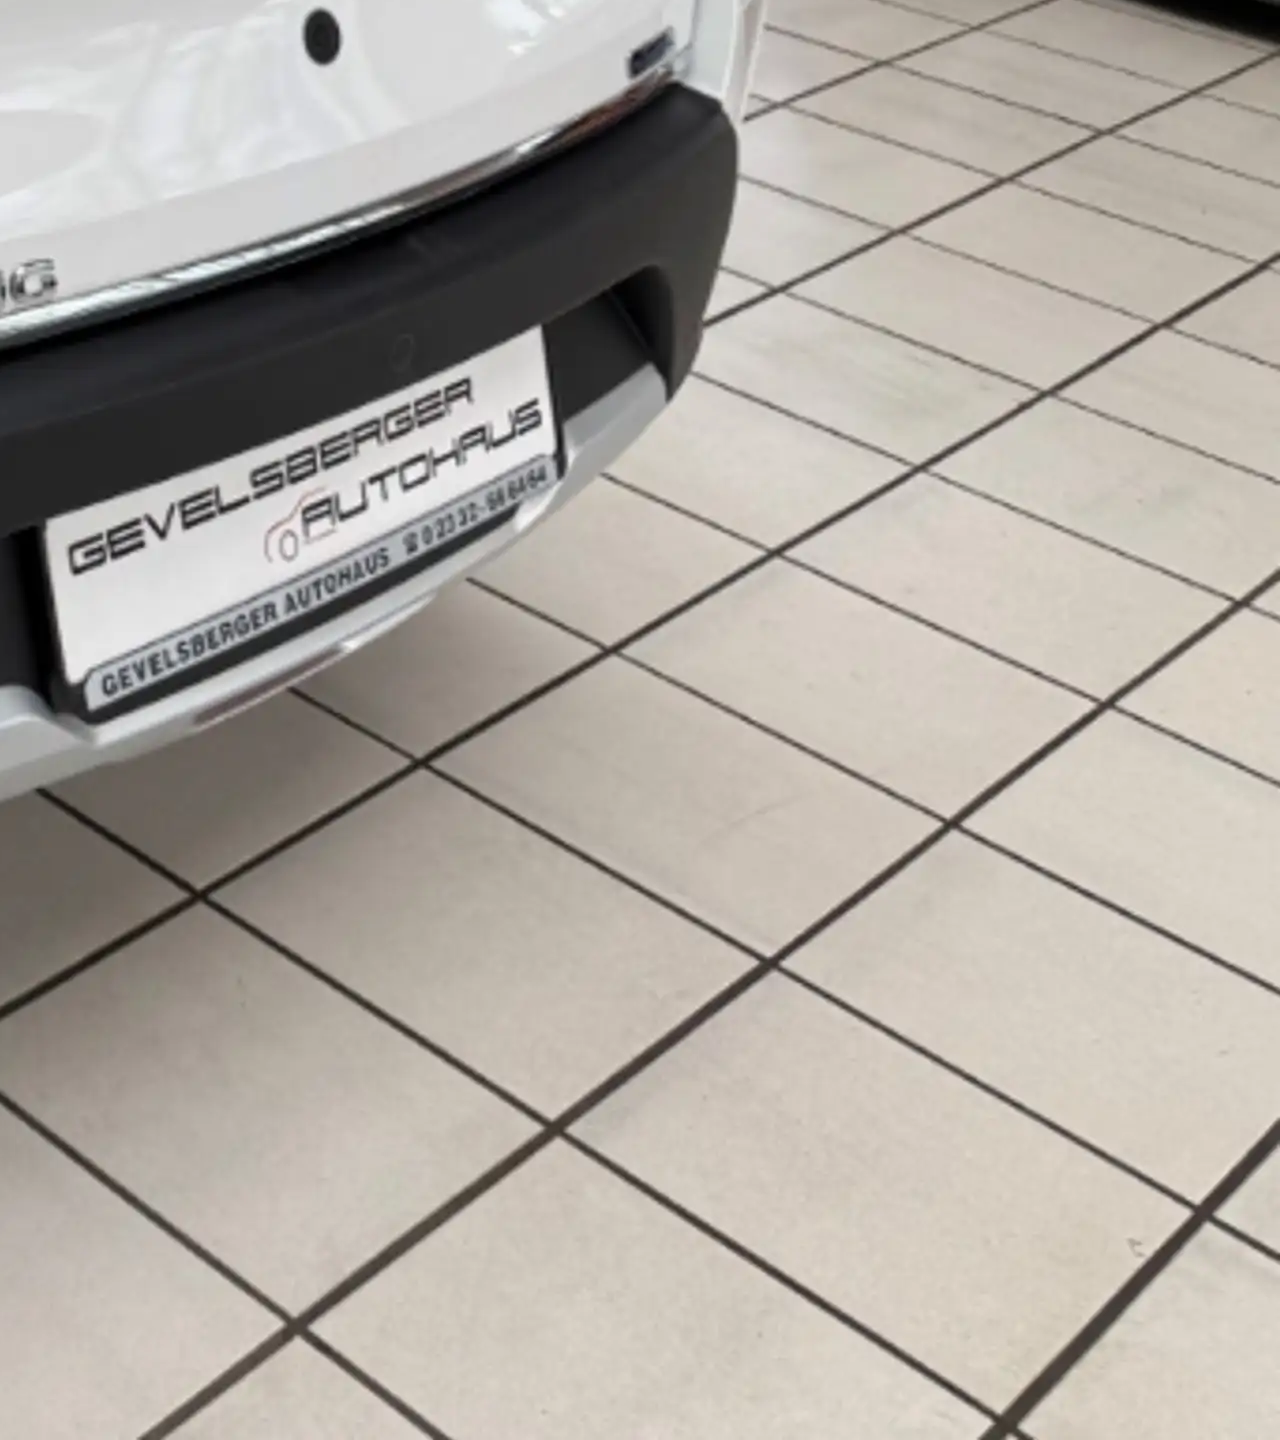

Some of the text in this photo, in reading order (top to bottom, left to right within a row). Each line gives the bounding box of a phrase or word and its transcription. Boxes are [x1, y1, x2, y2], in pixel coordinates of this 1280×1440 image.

[67, 376, 474, 576] GEVELSBERGER
[300, 397, 542, 538] AUTOHAUS
[101, 601, 278, 698] GEVELSBERGER
[284, 546, 390, 621] AUTOHAUS
